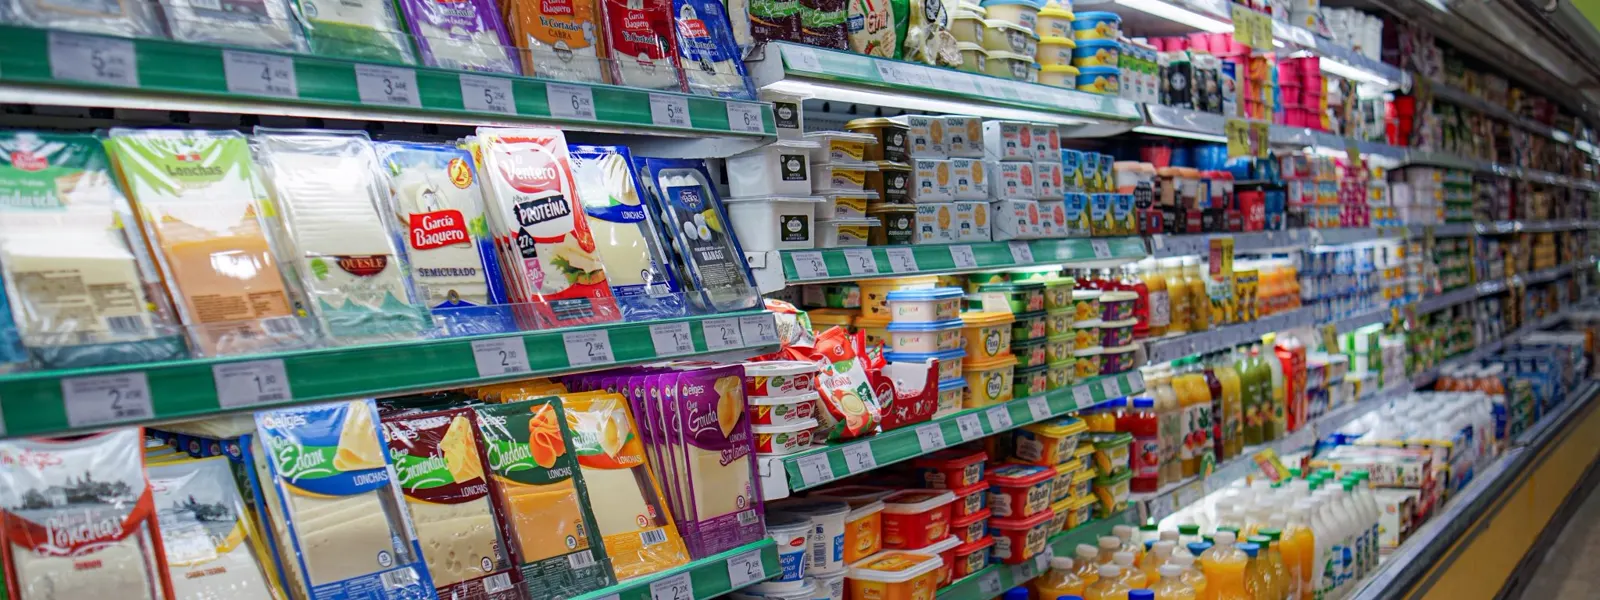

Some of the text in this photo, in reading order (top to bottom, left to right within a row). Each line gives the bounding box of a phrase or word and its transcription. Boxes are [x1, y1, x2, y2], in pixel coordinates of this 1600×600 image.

[484, 89, 493, 104] 5
[571, 95, 579, 110] 6
[667, 104, 675, 119] 5
[166, 163, 224, 177] Lonchas
[501, 160, 557, 181] Ventero
[520, 198, 568, 224] PROTEÍNA
[422, 215, 454, 231] García
[413, 228, 464, 247] Baquero
[418, 267, 476, 277] SEMICURADO
[720, 327, 728, 341] 2
[586, 342, 595, 356] 2
[499, 350, 509, 366] 2
[688, 403, 718, 432] Gouda
[279, 444, 326, 477] Edam
[487, 436, 532, 471] Cheddar
[352, 469, 388, 486] LONCHAS
[547, 466, 572, 479] LONCHAS
[460, 483, 488, 497] LONCHAS
[745, 561, 752, 575] 2
[779, 556, 795, 565] ueijo
